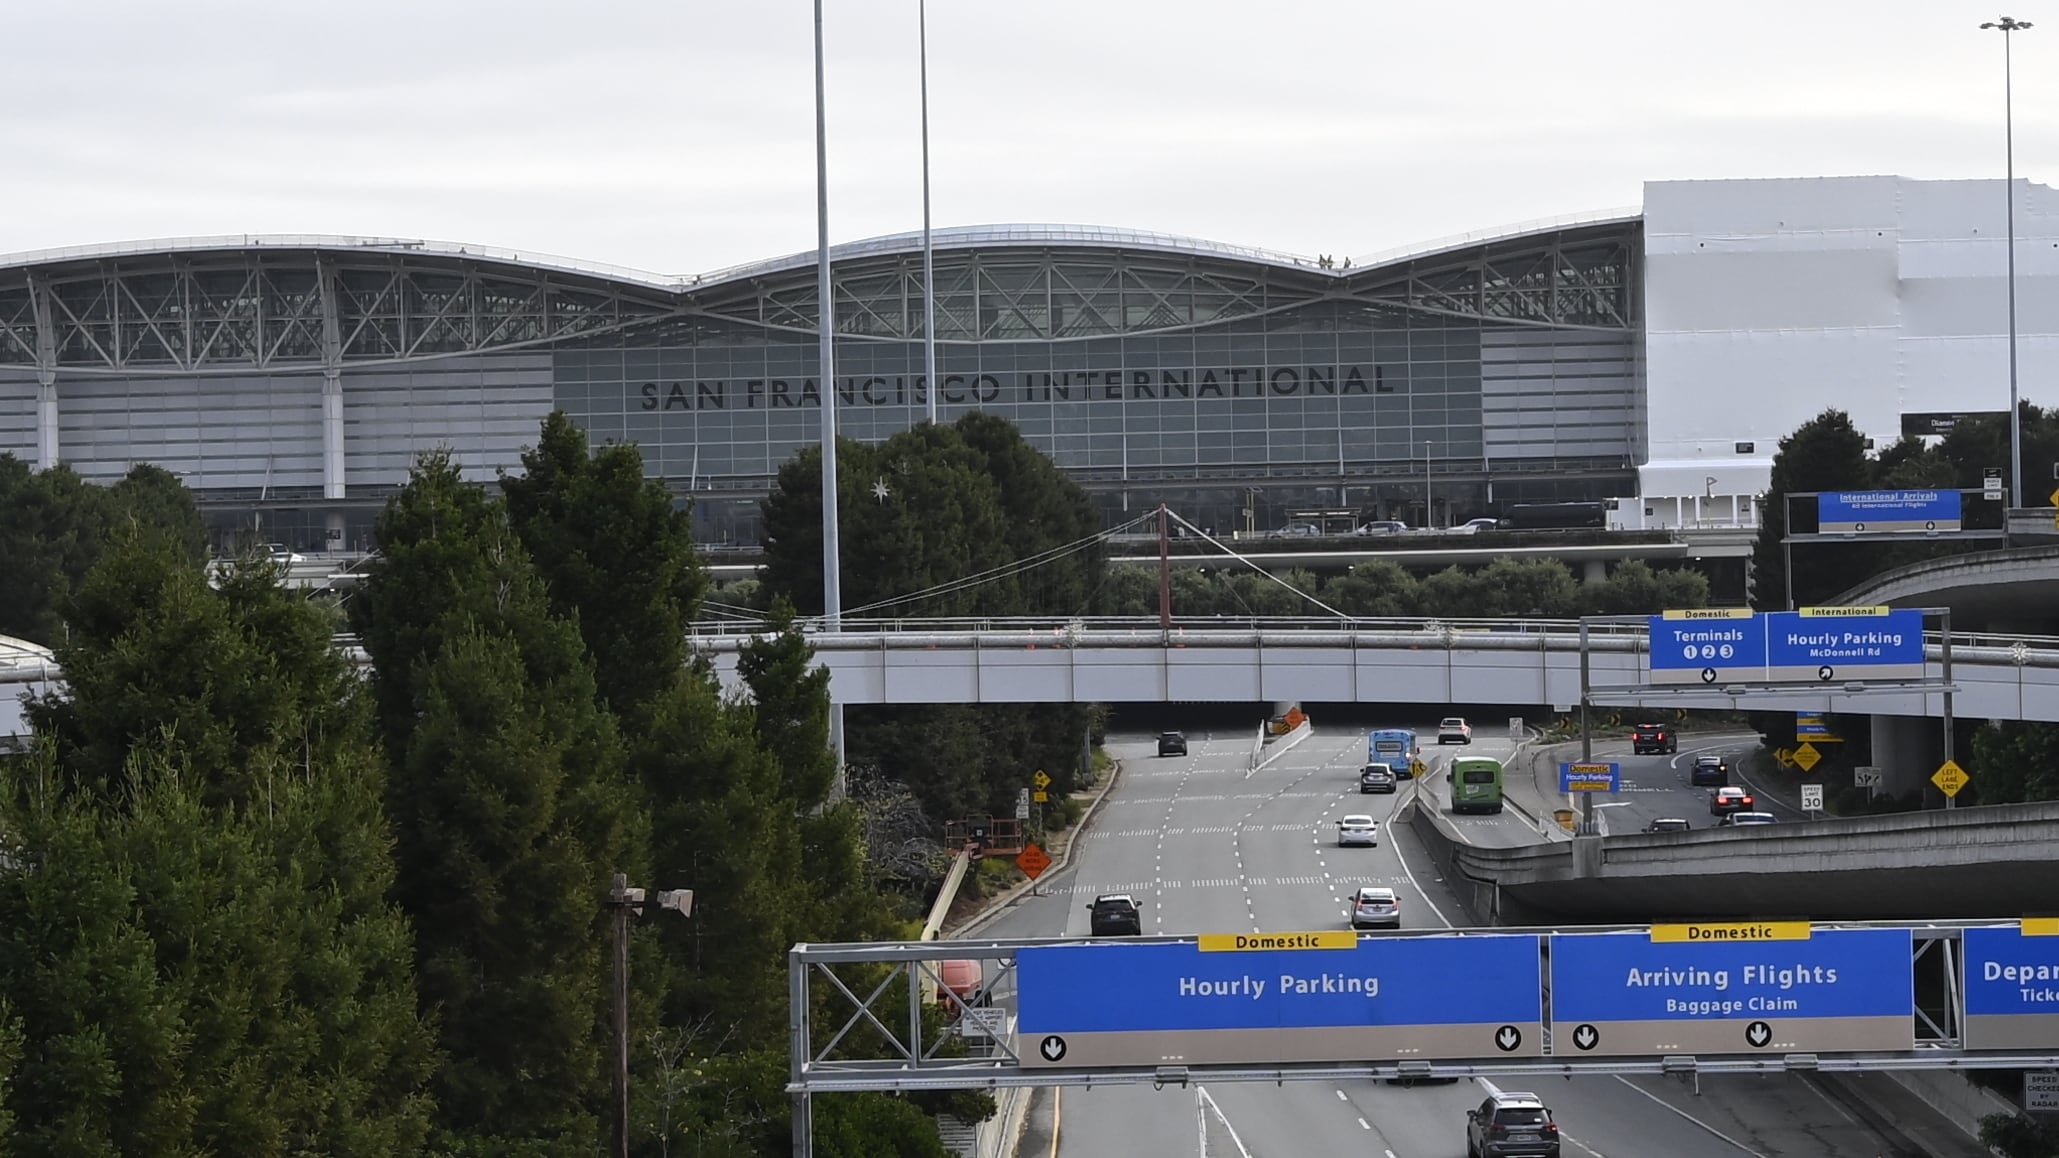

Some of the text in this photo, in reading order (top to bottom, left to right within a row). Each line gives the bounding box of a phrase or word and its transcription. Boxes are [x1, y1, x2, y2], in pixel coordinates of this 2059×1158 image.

[641, 366, 1394, 410] SAN FRANCISCO INTERNATIONAL
[1840, 491, 1938, 501] International Arrivals
[1685, 610, 1730, 619] Domestic
[1812, 607, 1876, 616] International
[1673, 629, 1743, 642] Terminals
[1788, 631, 1902, 648] Hourly Parking
[1809, 647, 1880, 657] McDonnell Rd
[1570, 764, 1609, 773] Domestic
[1566, 773, 1613, 782] Hourly Parking
[1804, 798, 1821, 808] 30
[1688, 925, 1772, 939] Domestic
[1236, 935, 1320, 949] Domestic
[1626, 964, 1838, 990] Arriving Flights
[1179, 973, 1379, 1000] Hourly Parking
[1666, 997, 1798, 1014] Baggage Claim
